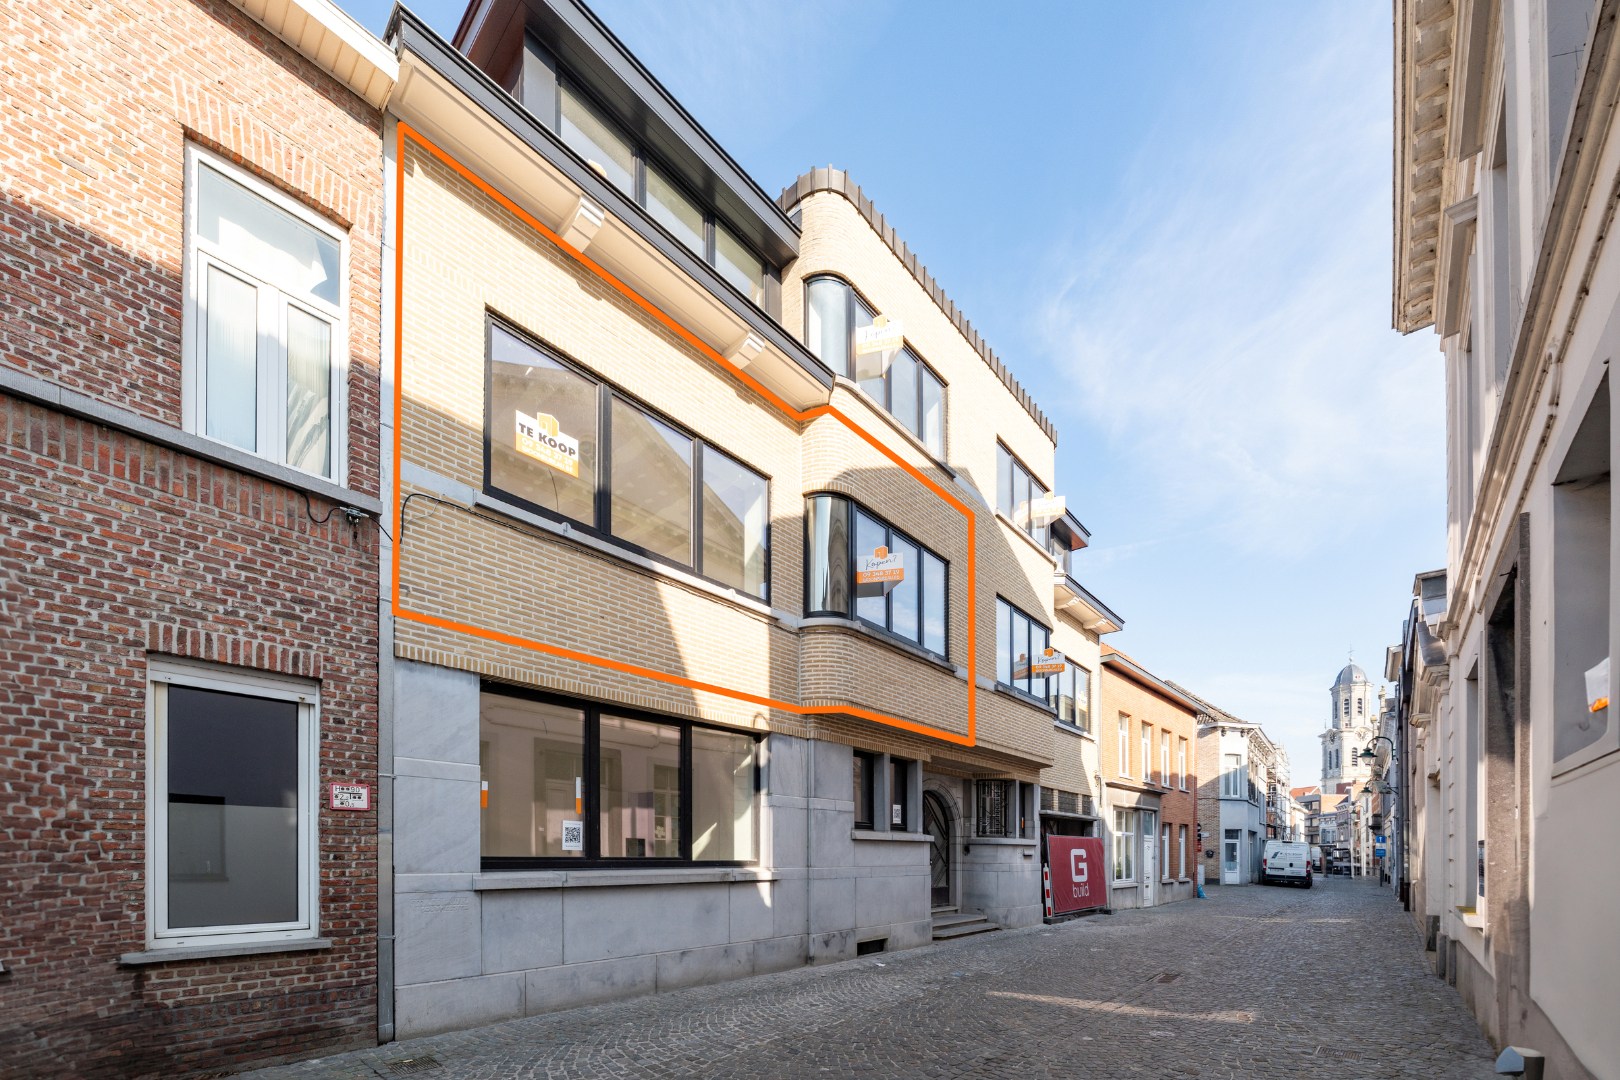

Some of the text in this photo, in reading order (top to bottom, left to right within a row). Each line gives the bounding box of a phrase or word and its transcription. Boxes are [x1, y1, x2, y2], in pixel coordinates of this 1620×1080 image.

[518, 422, 576, 456] TE KOOP
[1070, 848, 1088, 883] G
[1072, 883, 1090, 898] build
